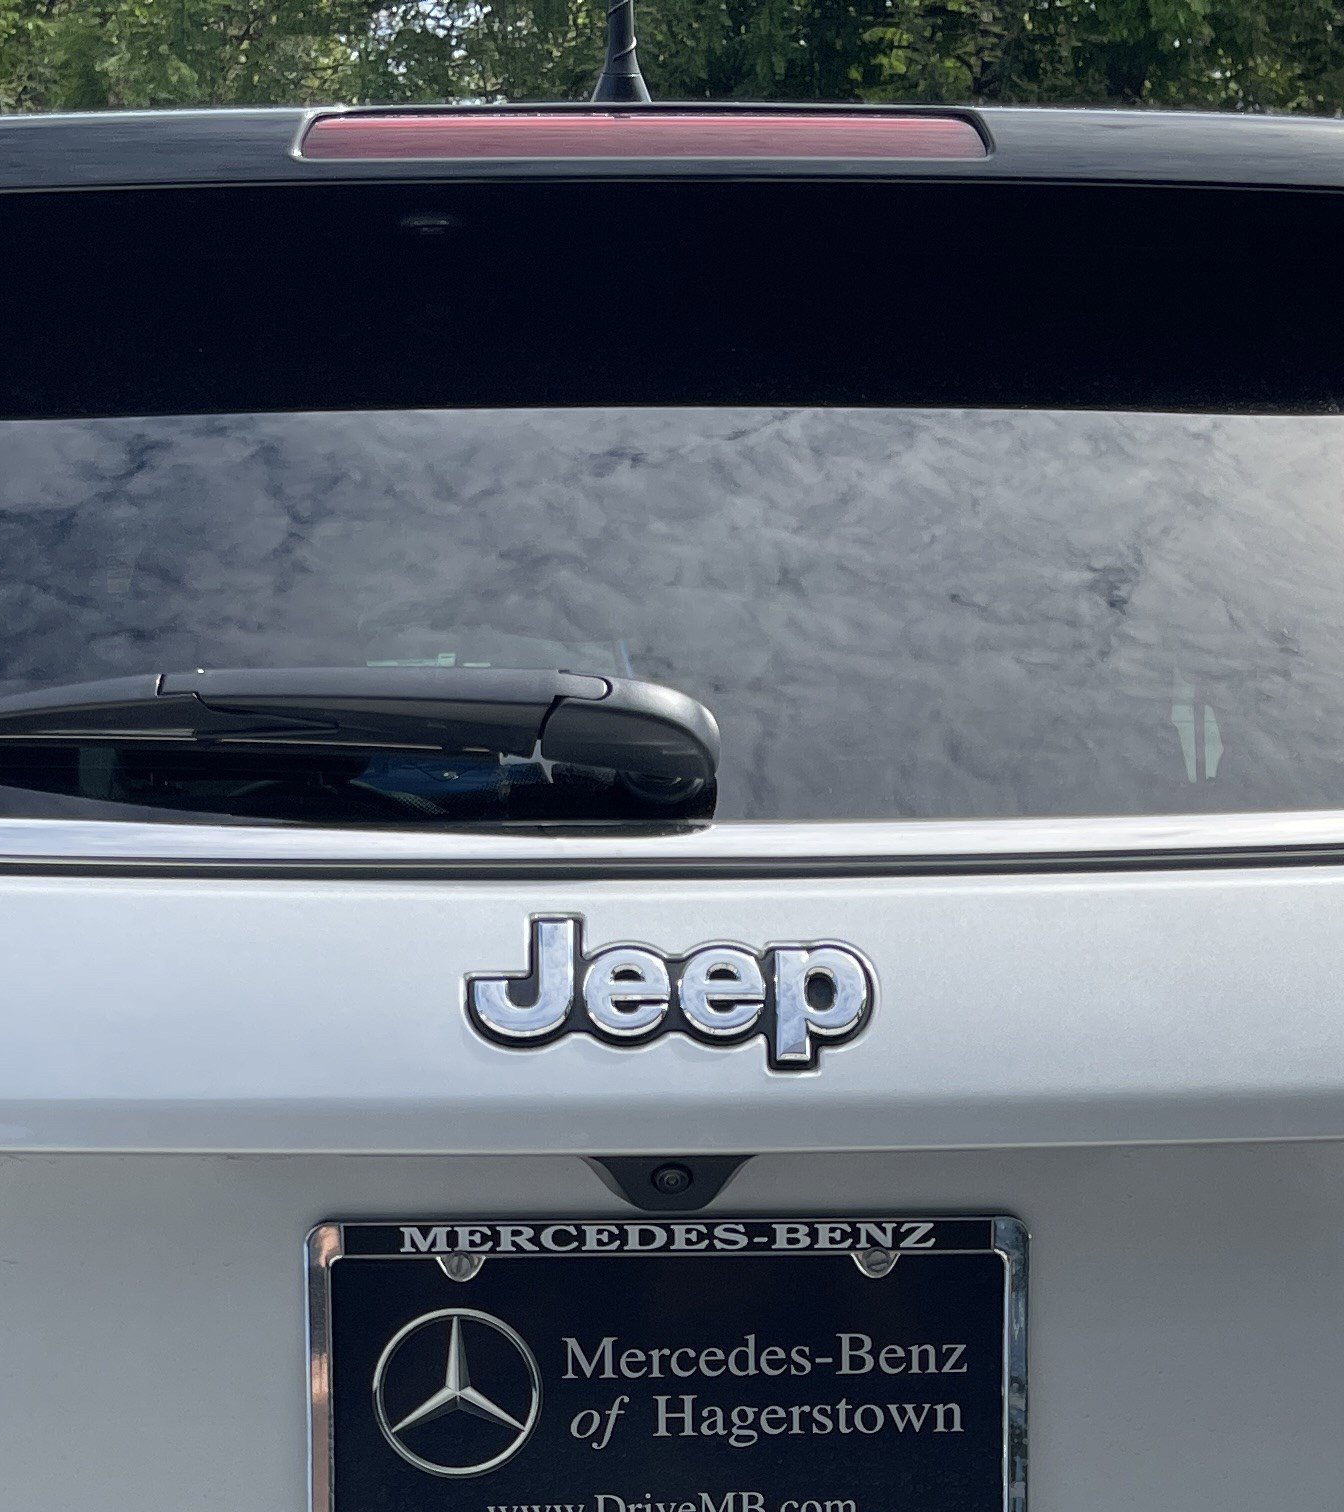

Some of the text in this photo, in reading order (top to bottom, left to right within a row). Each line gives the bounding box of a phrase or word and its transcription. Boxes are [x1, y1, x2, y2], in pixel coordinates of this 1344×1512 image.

[464, 912, 878, 1076] Jeep
[399, 1221, 938, 1254] MERCEDES-BENZ
[561, 1333, 968, 1379] Mercedes-Benz
[569, 1394, 965, 1449] of Hagerstown
